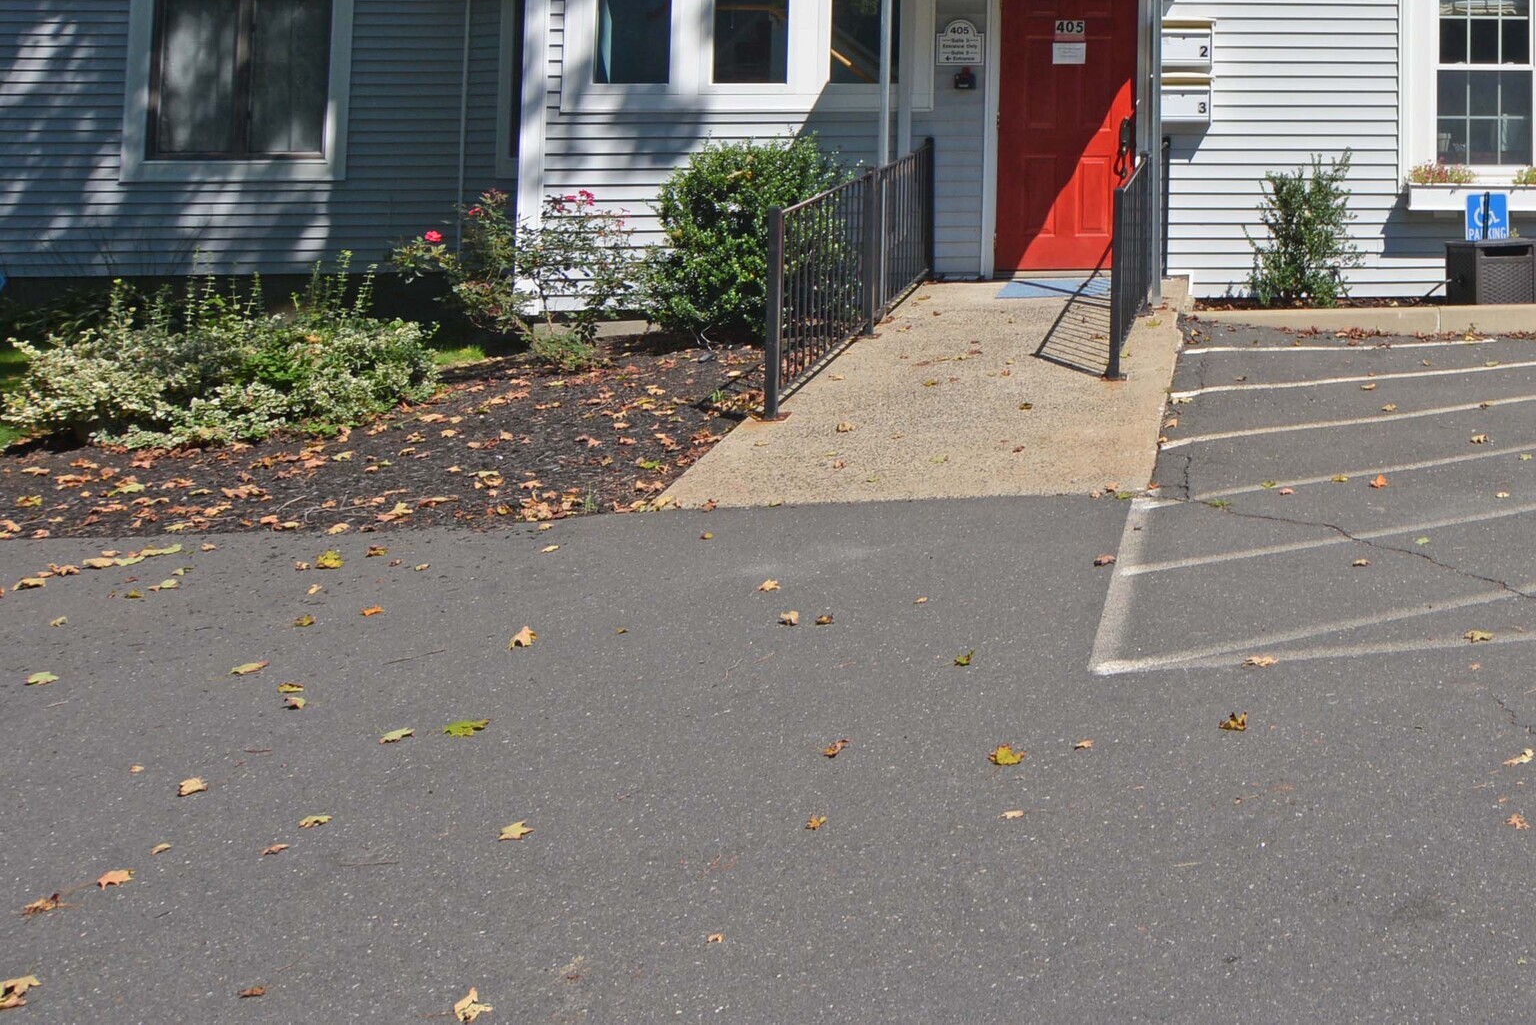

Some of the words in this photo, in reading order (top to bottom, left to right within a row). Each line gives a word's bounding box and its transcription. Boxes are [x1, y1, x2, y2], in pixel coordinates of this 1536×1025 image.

[950, 26, 969, 35] 405
[1056, 21, 1083, 33] 405
[1199, 45, 1208, 57] 2
[1198, 102, 1207, 113] 3
